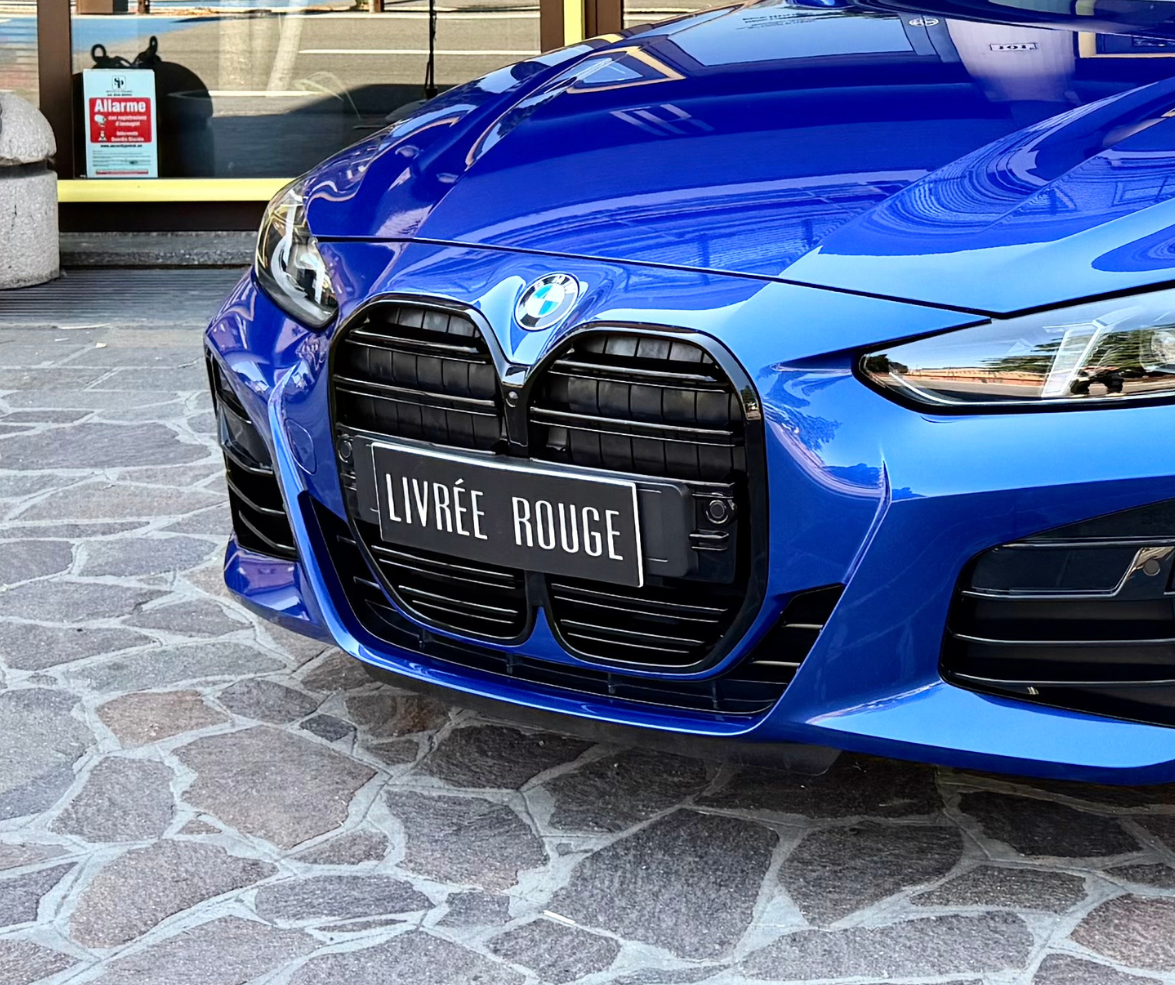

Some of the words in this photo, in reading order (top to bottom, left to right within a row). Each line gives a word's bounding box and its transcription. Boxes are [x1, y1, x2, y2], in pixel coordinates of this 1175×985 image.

[94, 98, 147, 113] Allarme
[385, 473, 488, 540] LIVRÉE
[512, 496, 623, 561] ROUGE
